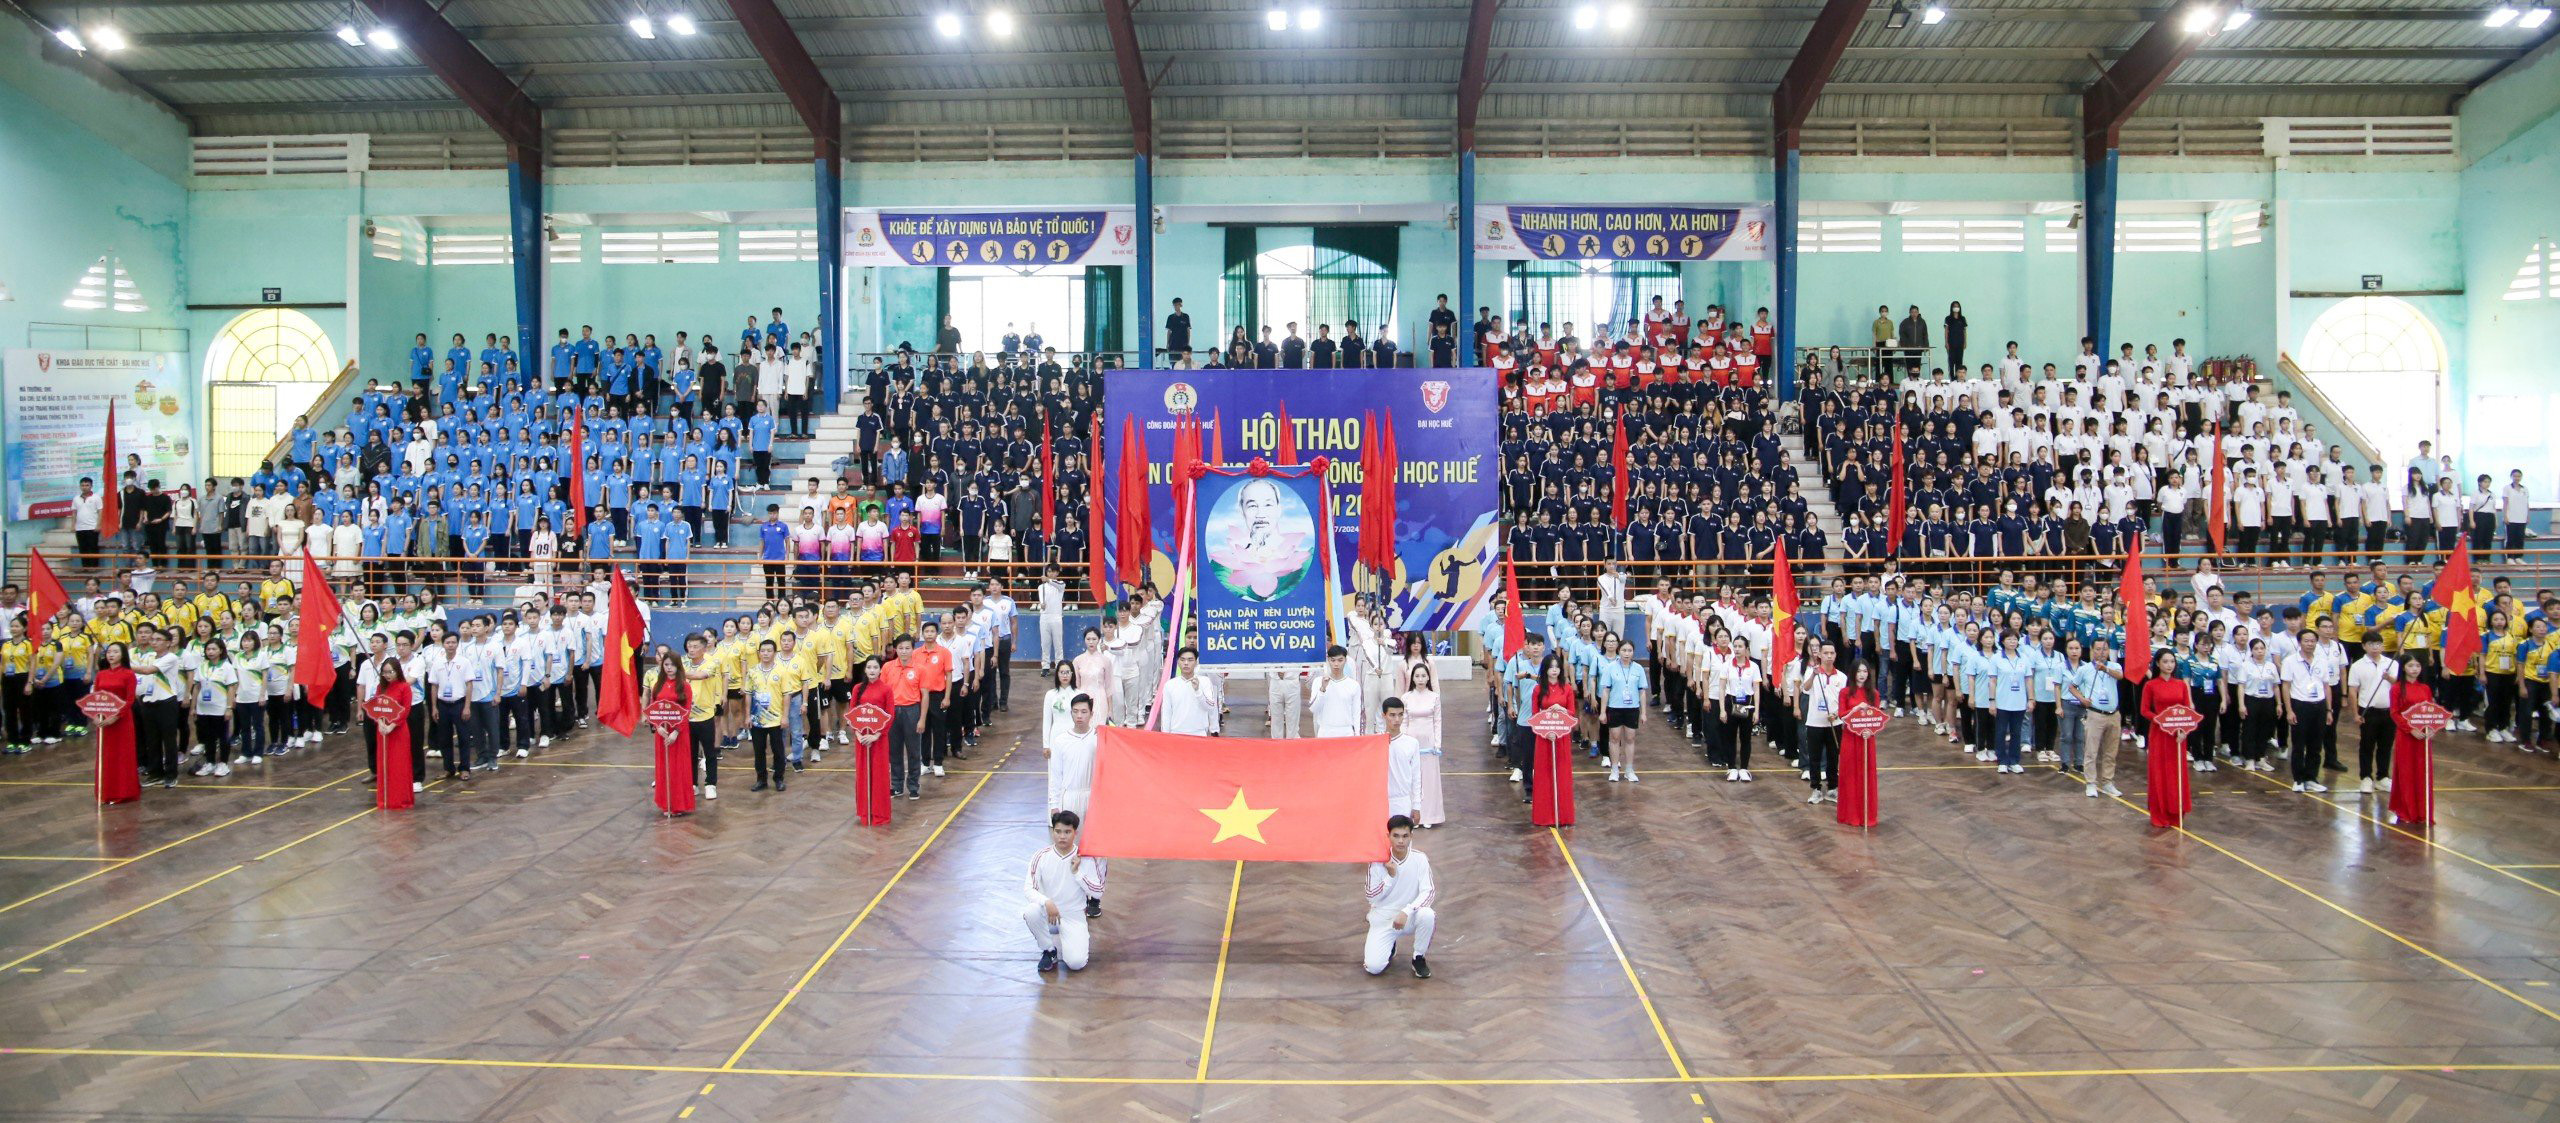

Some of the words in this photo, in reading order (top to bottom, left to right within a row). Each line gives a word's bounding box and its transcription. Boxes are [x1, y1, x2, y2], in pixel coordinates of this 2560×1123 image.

[890, 218, 916, 235] KHỎE
[920, 216, 936, 235] ĐỂ
[936, 219, 958, 235] XÂY
[960, 220, 986, 238] DỰNG
[990, 218, 1004, 235] VÀ
[1006, 217, 1026, 234] BẢO
[1029, 218, 1044, 238] VỆ
[1045, 216, 1060, 234] TỔ
[1062, 216, 1089, 234] QUỐC
[1090, 220, 1095, 234] !
[1521, 214, 1568, 230] NHANH
[1571, 213, 1602, 232] HƠN,
[1606, 214, 1632, 230] CAO
[1635, 213, 1666, 232] HƠN,
[1670, 214, 1688, 230] XA
[1692, 214, 1718, 230] HƠN
[1722, 215, 1726, 230] !
[1146, 420, 1162, 429] CÔNG
[1418, 420, 1428, 429] ĐẠI
[1429, 420, 1440, 429] HỌC
[1441, 417, 1454, 428] HUẾ
[1291, 418, 1360, 450] THAO
[1327, 457, 1364, 488] ỘNG
[1404, 461, 1438, 488] HỌC
[1444, 454, 1482, 483] HUẾ
[536, 544, 550, 555] 09
[1206, 608, 1232, 618] TOÀN
[1238, 607, 1258, 618] DÂN
[1264, 606, 1282, 617] RÈN
[1287, 606, 1315, 618] LUYỆN
[1206, 620, 1231, 630] THÂN
[1254, 621, 1277, 629] THEO
[1280, 620, 1315, 629] GƯƠNG
[1207, 634, 1237, 651] BÁC
[1242, 632, 1265, 650] HỒ
[1270, 633, 1285, 650] VĨ
[1289, 635, 1315, 652] ĐẠI
